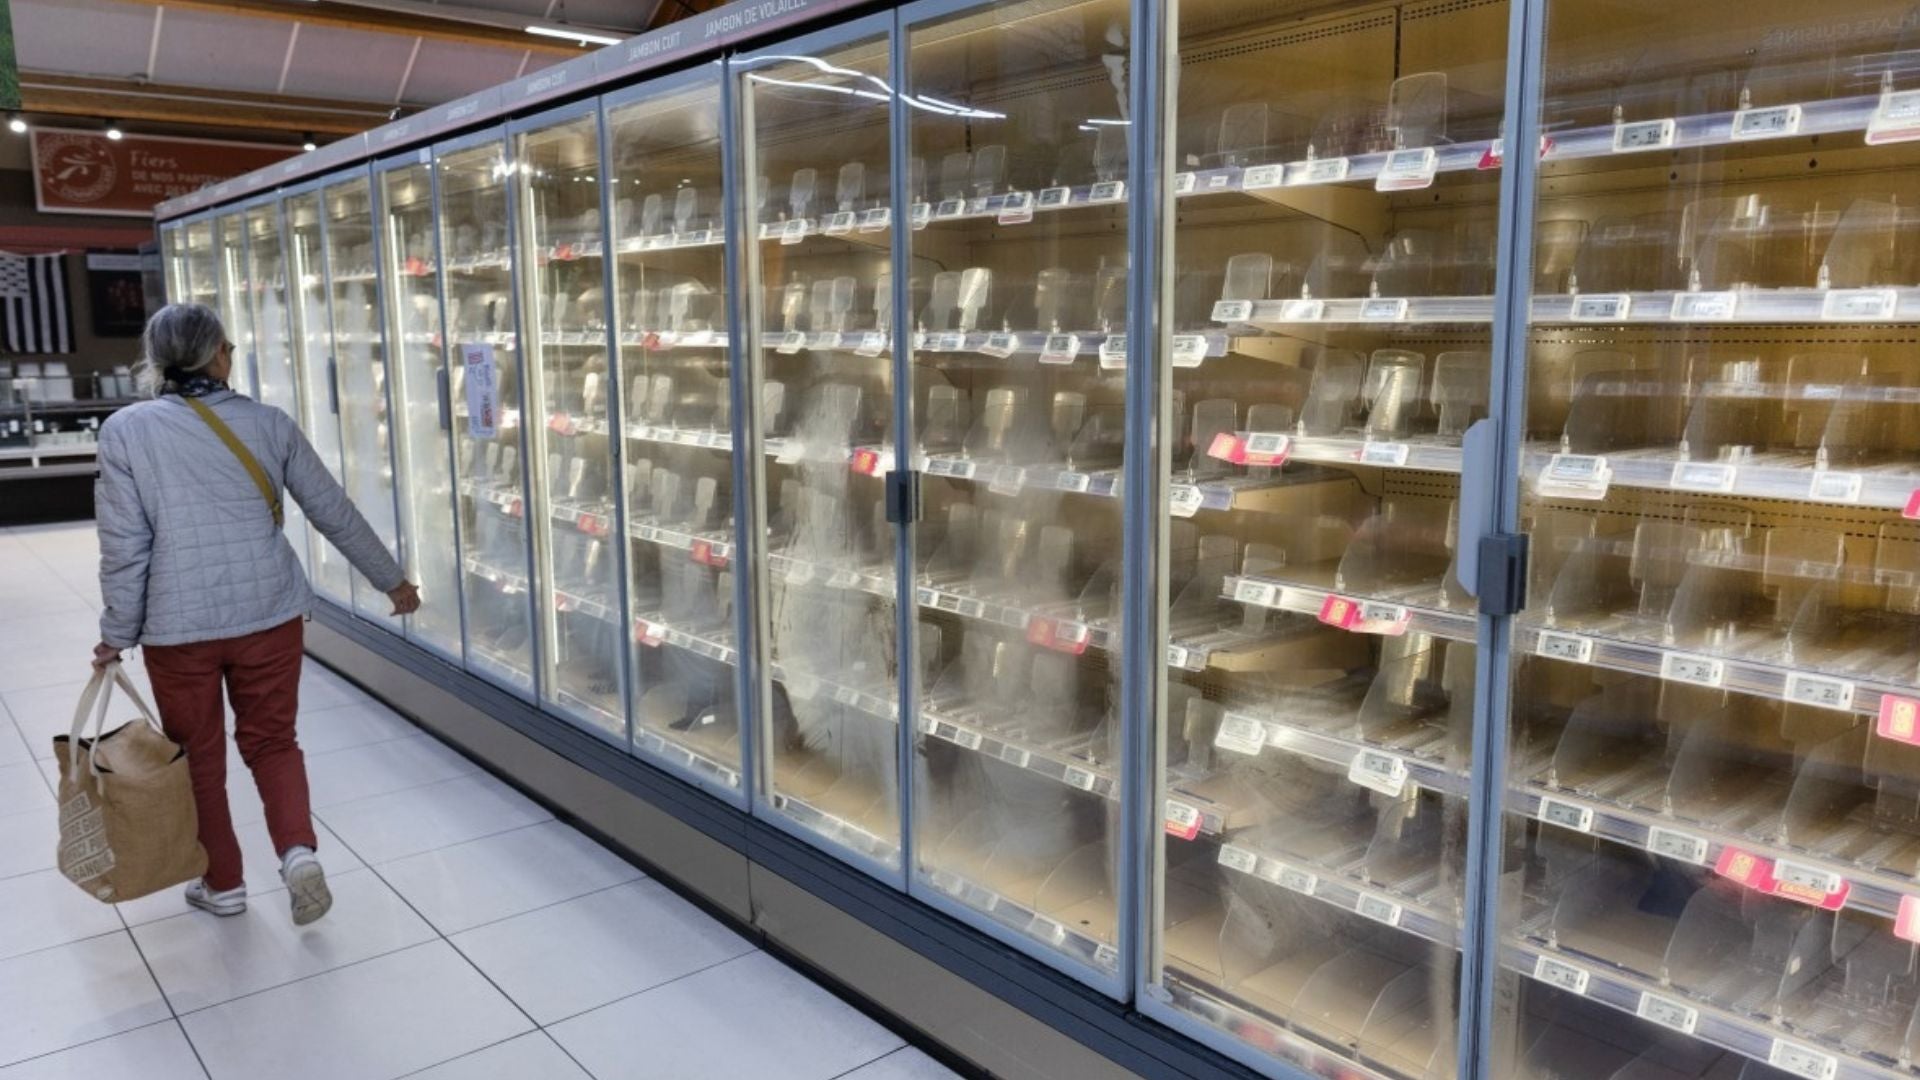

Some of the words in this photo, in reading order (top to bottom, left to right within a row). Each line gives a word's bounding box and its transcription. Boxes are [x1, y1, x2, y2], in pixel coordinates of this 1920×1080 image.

[704, 11, 743, 39] JAMBON
[743, 5, 757, 24] DE
[627, 38, 660, 61] JAMBON
[660, 31, 681, 50] CUIT
[130, 150, 178, 169] Fiers
[131, 170, 147, 181] DE
[150, 171, 175, 183] NOS
[132, 182, 163, 194] AVEC
